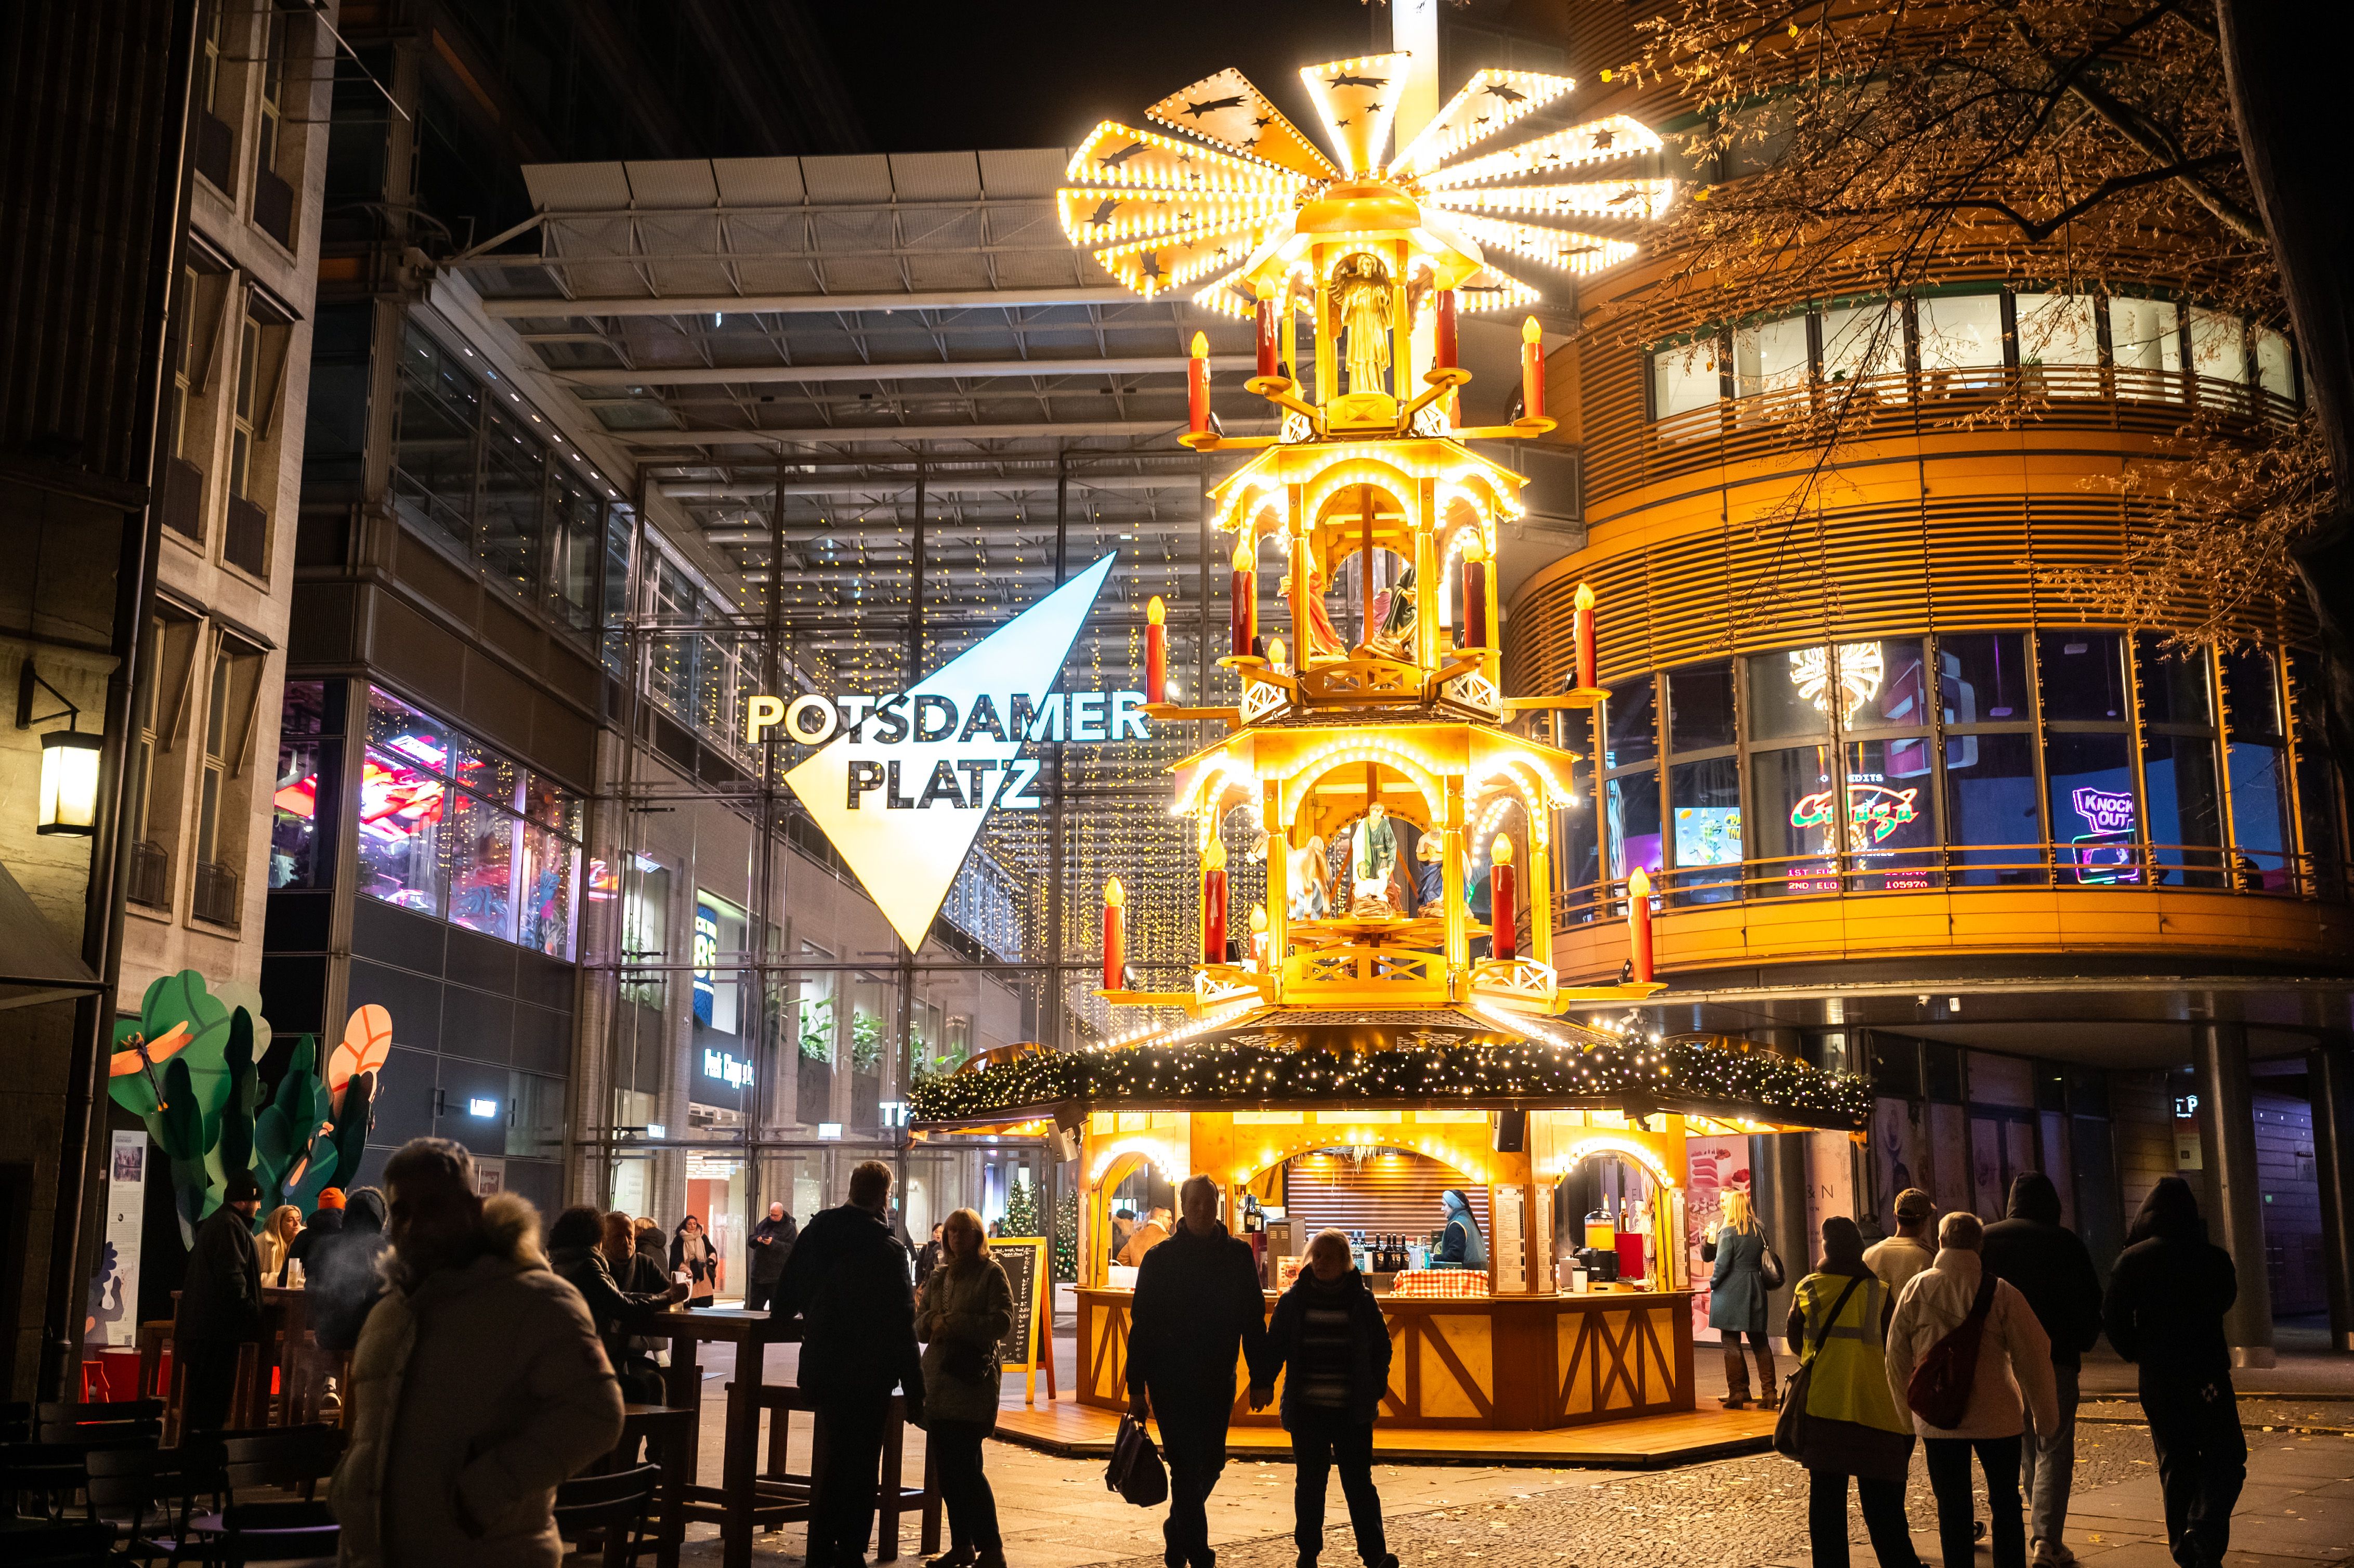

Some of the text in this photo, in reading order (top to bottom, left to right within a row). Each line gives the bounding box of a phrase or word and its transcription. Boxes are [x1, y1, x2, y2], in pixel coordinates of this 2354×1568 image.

[747, 690, 1151, 745] POTSDAMER
[847, 759, 1040, 809] PLATZ
[1847, 774, 1884, 782] EDITS
[2085, 795, 2133, 813] KNOCK
[2098, 811, 2129, 827] OUT
[1788, 881, 1810, 890] 2ND
[1885, 880, 1928, 890] 105970
[2187, 1097, 2198, 1113] P
